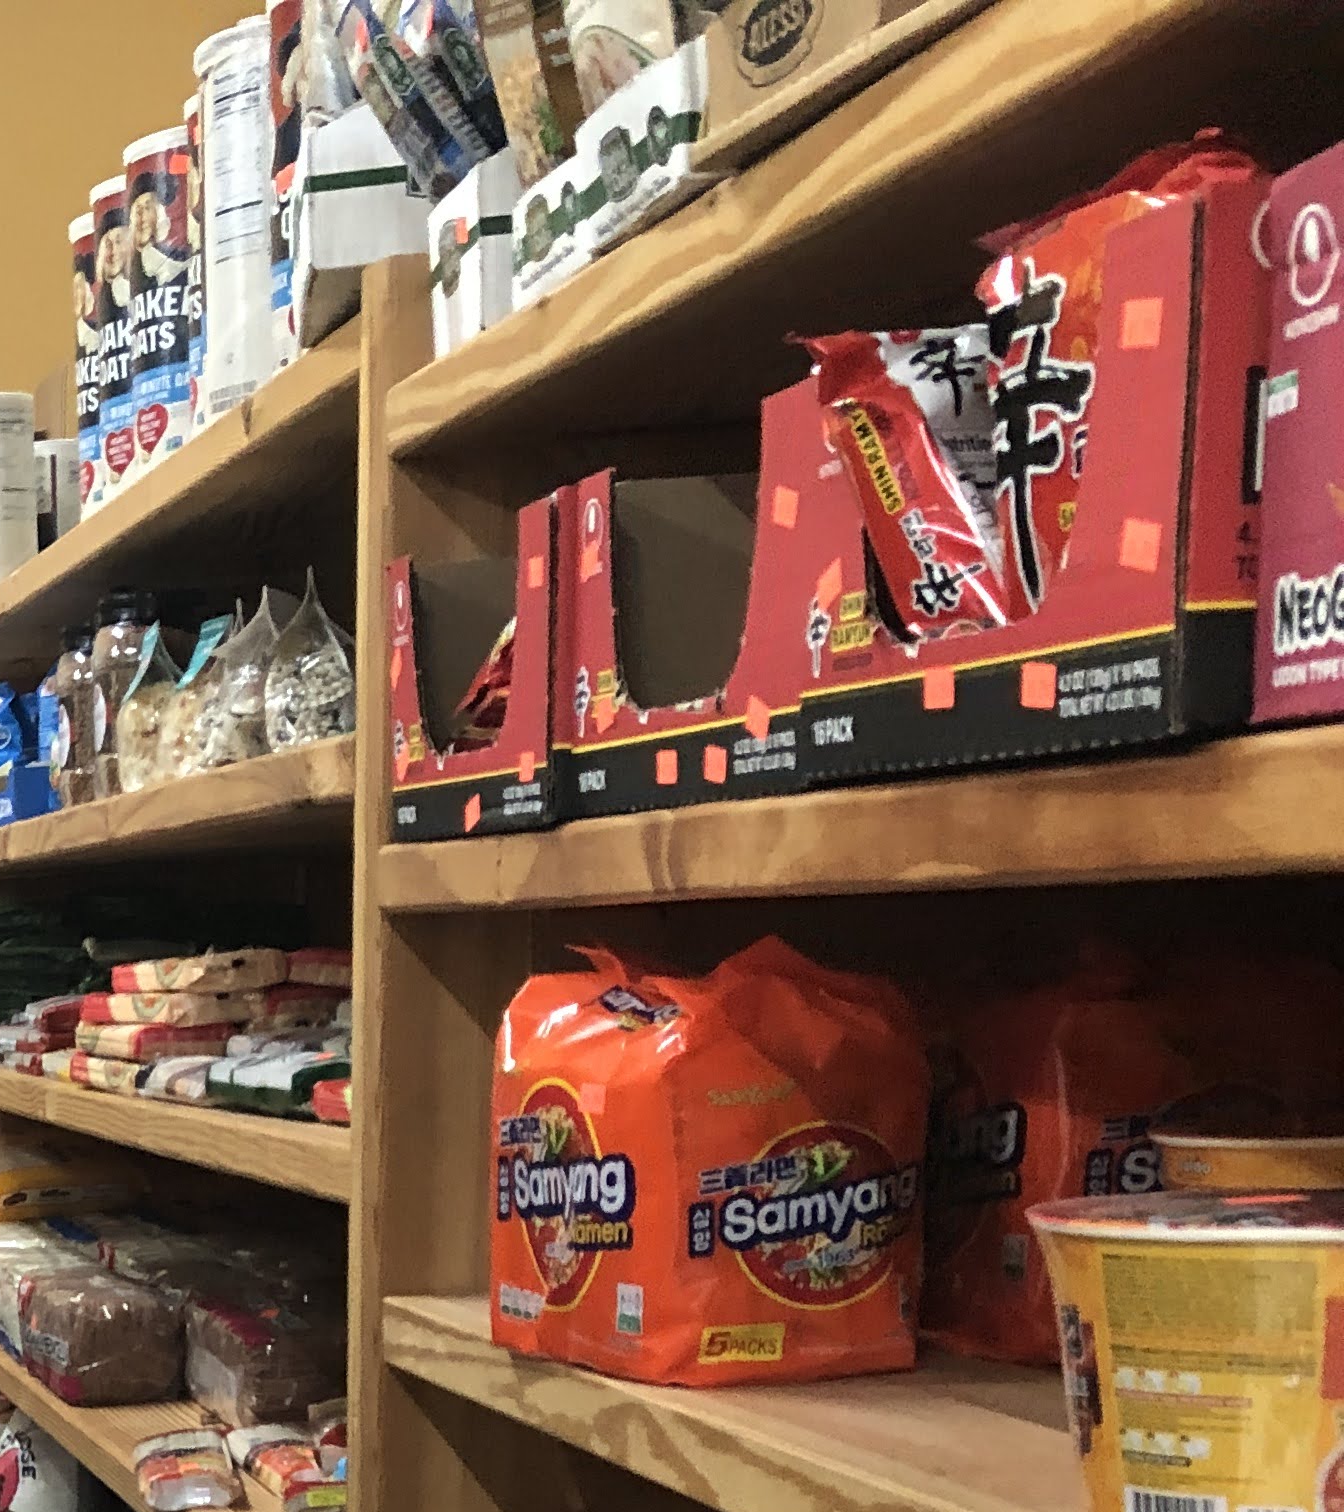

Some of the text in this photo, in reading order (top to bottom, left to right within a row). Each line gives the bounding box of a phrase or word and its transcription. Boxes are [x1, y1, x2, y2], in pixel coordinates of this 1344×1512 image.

[873, 464, 905, 515] SHIN
[1273, 564, 1344, 657] NEOG
[512, 1152, 626, 1218] Samyang
[721, 1160, 920, 1244] Samyang
[705, 1331, 778, 1357] 5 PACKS
